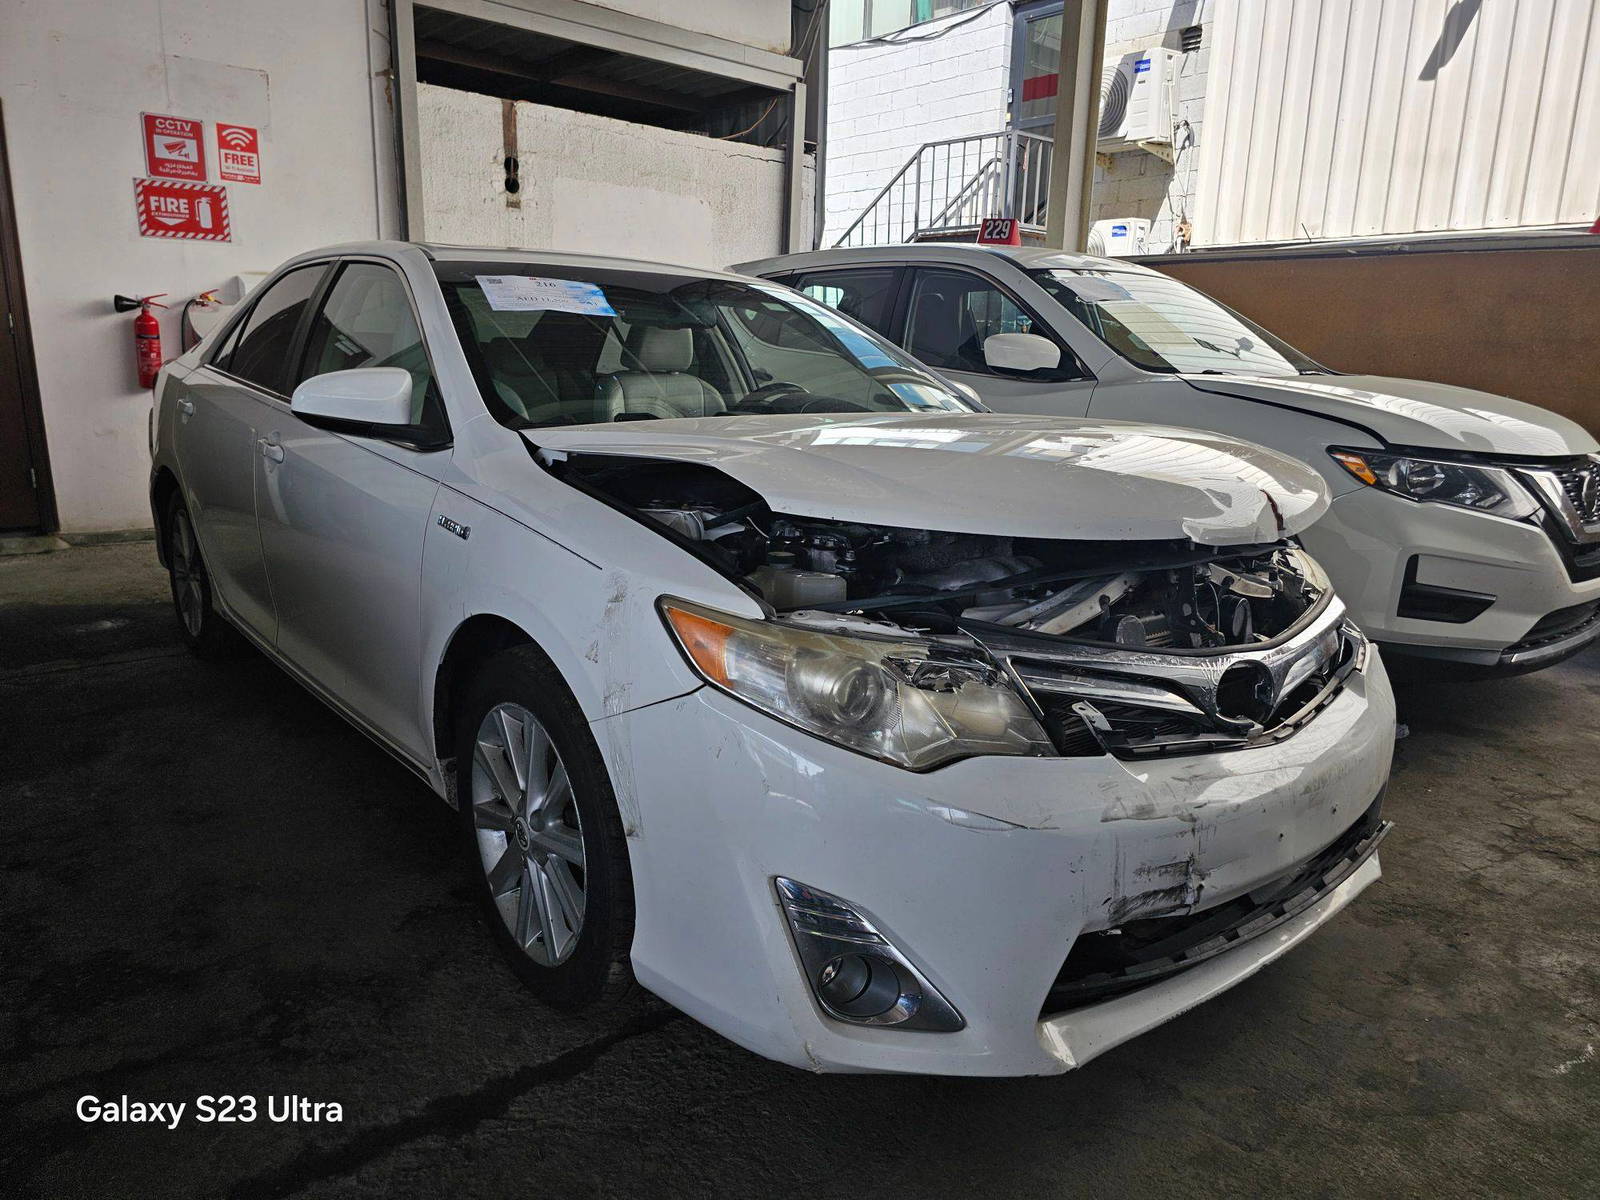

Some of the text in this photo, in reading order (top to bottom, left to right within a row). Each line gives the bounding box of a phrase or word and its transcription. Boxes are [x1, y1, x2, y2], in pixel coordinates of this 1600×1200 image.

[155, 118, 192, 132] CCTV
[224, 152, 254, 167] FREE
[149, 196, 190, 214] FIRE
[984, 220, 1011, 239] 229
